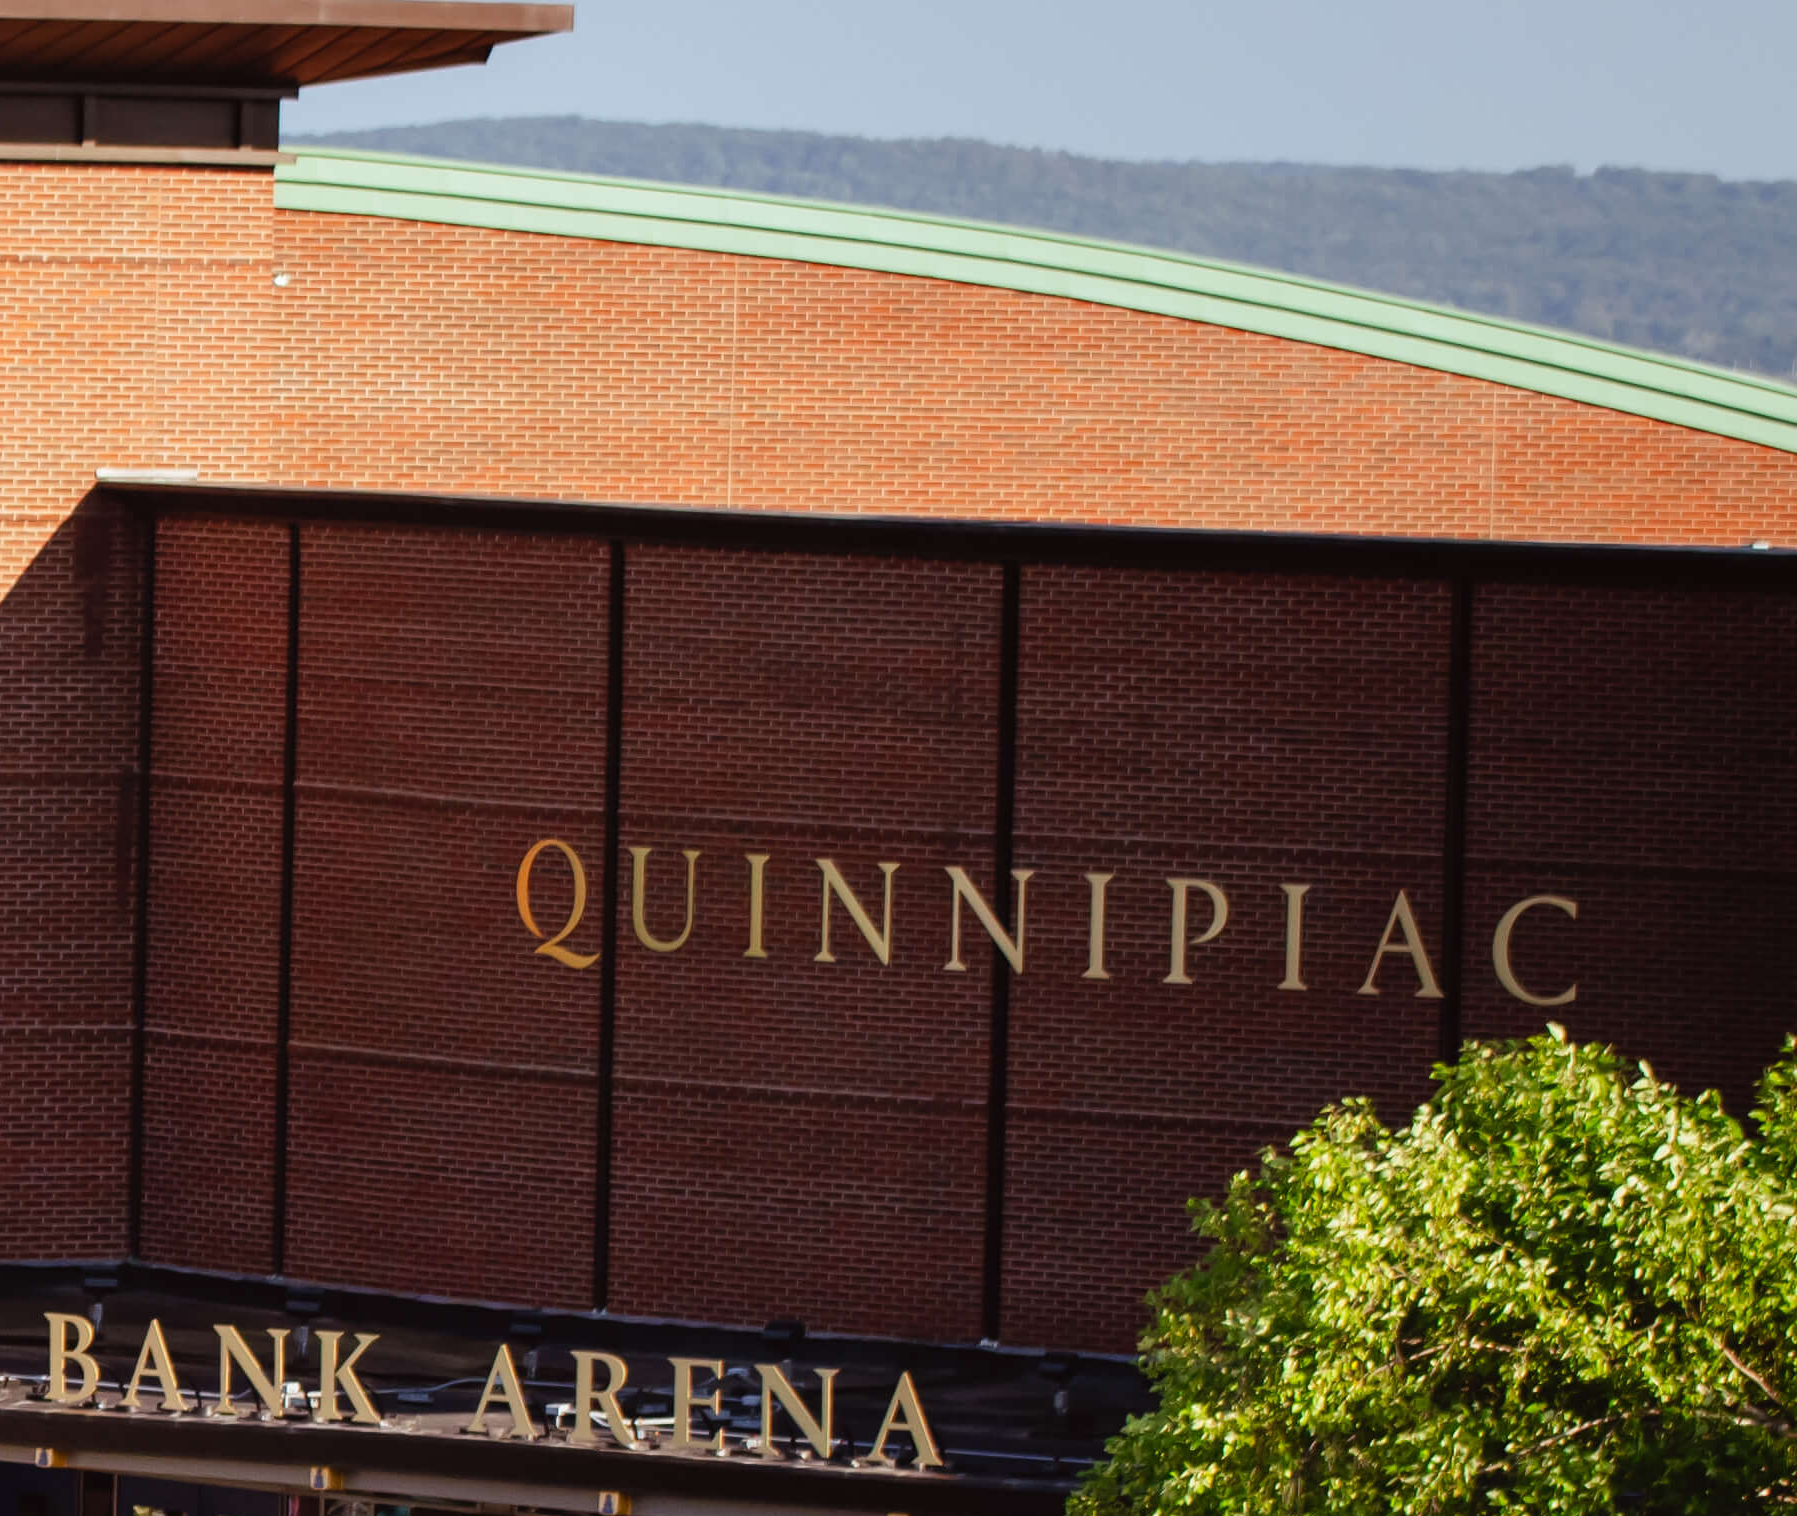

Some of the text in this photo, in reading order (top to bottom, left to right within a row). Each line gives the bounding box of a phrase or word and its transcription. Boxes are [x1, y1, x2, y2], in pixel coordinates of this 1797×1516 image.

[515, 837, 1579, 1006] QUINNIPIAC
[44, 1312, 386, 1425] BANK
[469, 1343, 944, 1474] ARENA
